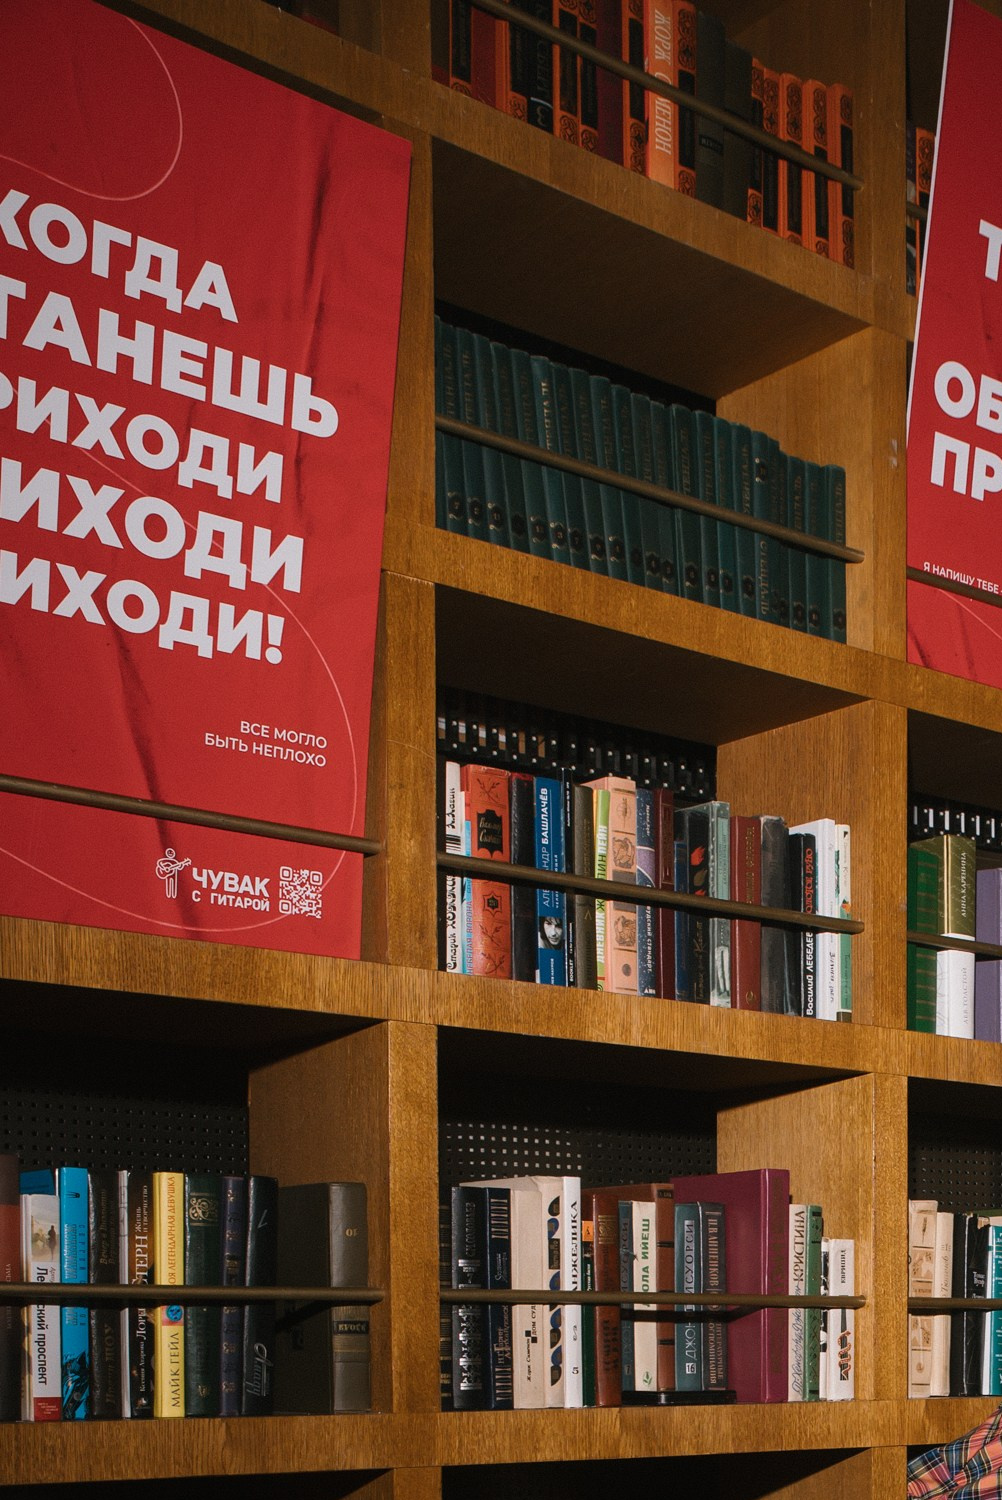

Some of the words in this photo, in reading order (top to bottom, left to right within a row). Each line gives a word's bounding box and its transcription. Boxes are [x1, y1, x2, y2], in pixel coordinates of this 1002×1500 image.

[654, 9, 673, 65] ЖОРЖ
[654, 70, 672, 155] СМЕНОН
[204, 732, 249, 753] БЫТЬ
[251, 742, 327, 768] НЕПЛОХО
[240, 720, 271, 738] ВСЕ
[273, 725, 328, 750] МОГЛО
[539, 787, 551, 845] БАШЛАЧЁВ
[191, 866, 271, 898] ЧУВАК
[958, 852, 971, 894] КАРЕНИНА
[191, 890, 201, 902] С
[210, 892, 271, 912] ГИТАРОЙ
[959, 894, 971, 918] АННА
[804, 974, 816, 1016] Василий
[960, 967, 971, 1009] ТОЛСТОЙ
[962, 1009, 972, 1026] ЛЕВ
[166, 1176, 177, 1214] ДЕВУШКА
[167, 1215, 178, 1272] ЛЕГЕНДАРНАЯ
[640, 1219, 649, 1261] ИЙЕШ
[793, 1210, 805, 1283] КРИСТИНА
[168, 1332, 180, 1365] ГЕЙЛ
[530, 1321, 538, 1337] ДОМ
[685, 1322, 698, 1360] ДЖОН
[34, 1332, 49, 1385] проспект
[170, 1367, 181, 1408] МАЙК
